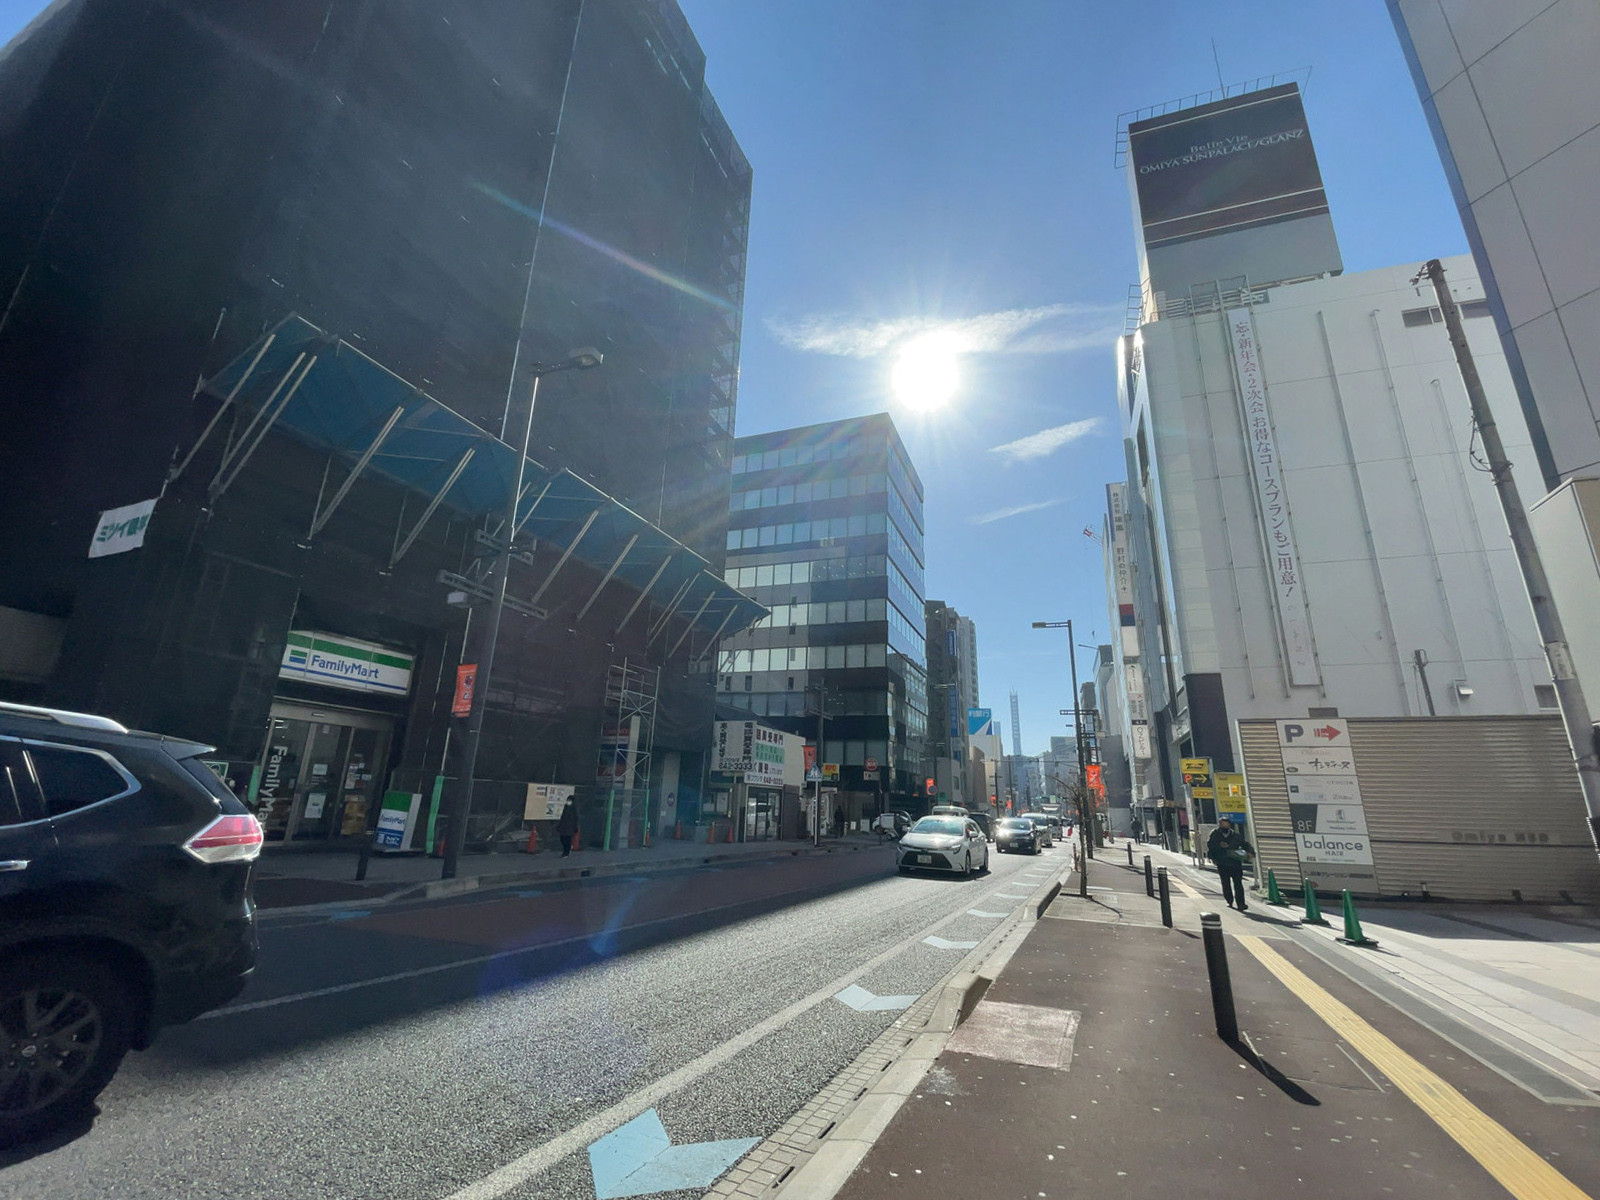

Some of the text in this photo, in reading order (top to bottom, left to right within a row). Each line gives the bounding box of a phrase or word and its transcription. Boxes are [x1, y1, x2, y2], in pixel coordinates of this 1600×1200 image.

[1139, 159, 1180, 174] OMIYA
[310, 654, 380, 680] FamilyMart
[1284, 724, 1304, 743] P
[1297, 820, 1313, 832] 8F
[1302, 834, 1364, 851] balance
